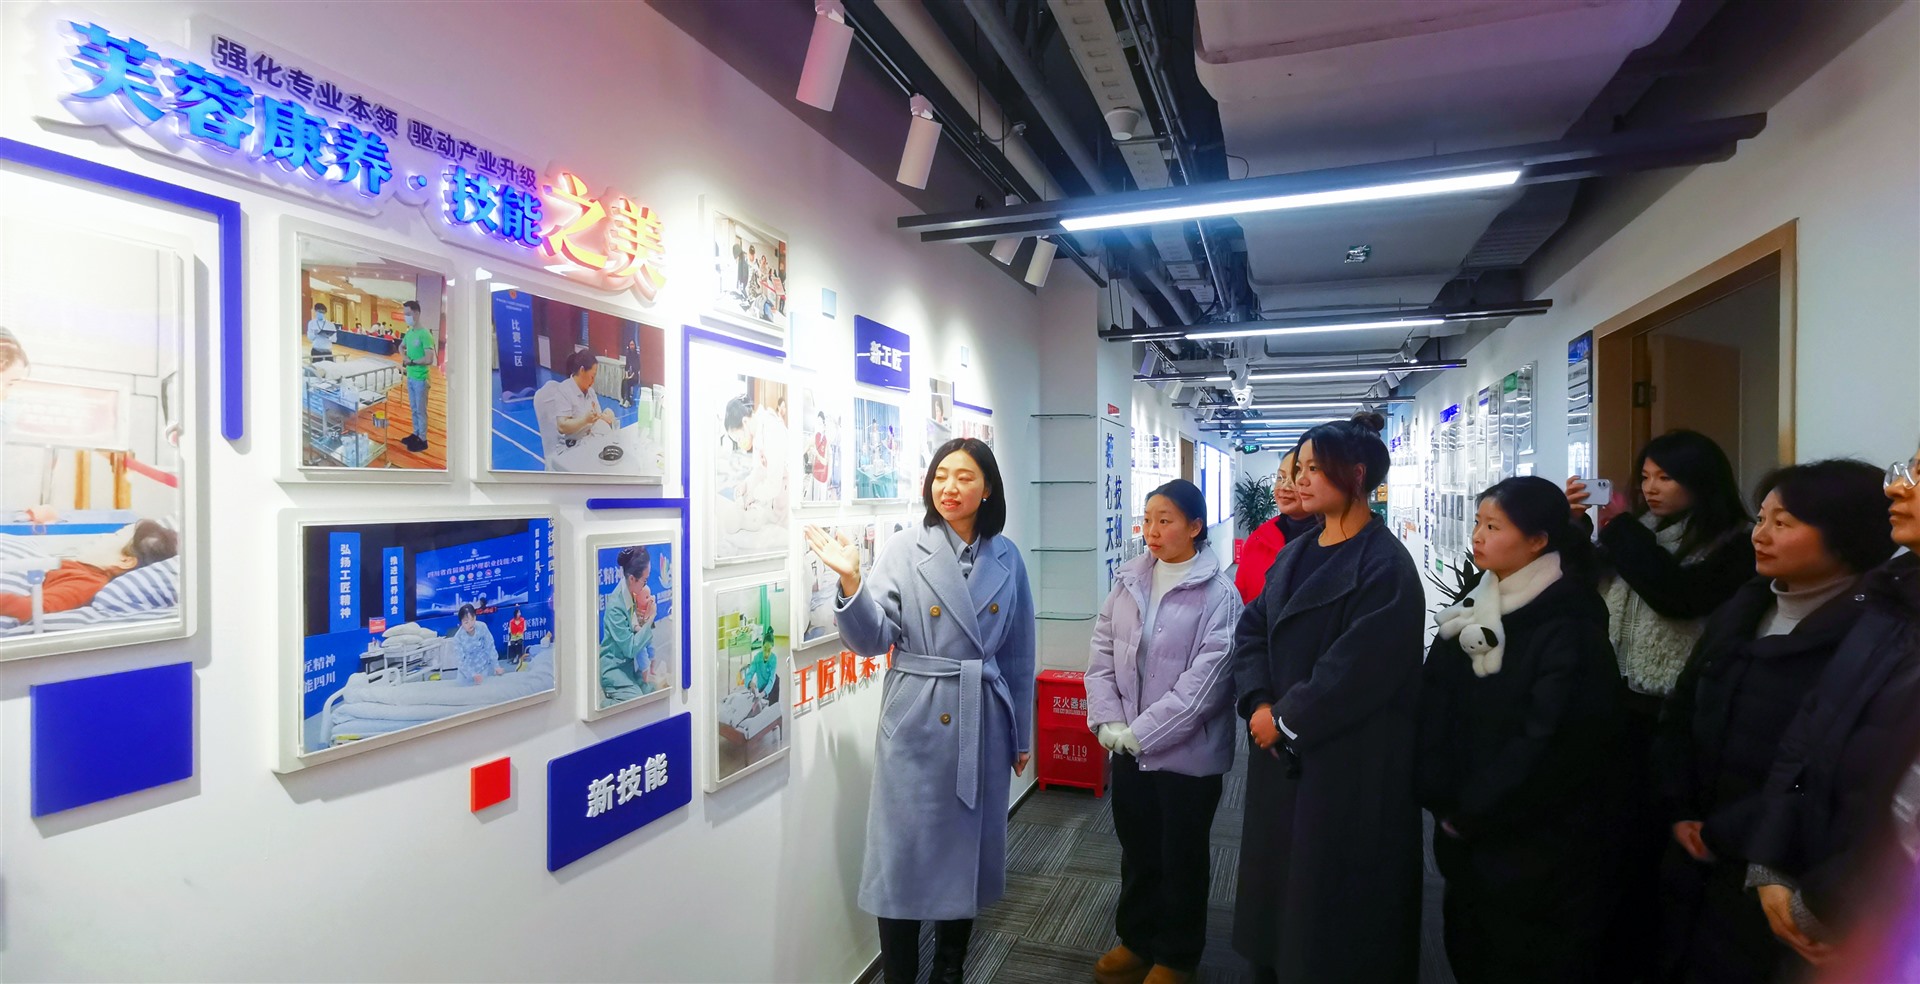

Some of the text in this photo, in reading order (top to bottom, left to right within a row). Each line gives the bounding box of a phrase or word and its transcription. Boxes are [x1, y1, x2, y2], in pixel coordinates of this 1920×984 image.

[215, 37, 537, 190] 强化专业本领 驱动产业升级
[511, 319, 523, 367] 比赛二区
[870, 340, 902, 372] 新工匠
[340, 544, 351, 619] 弘扬工匠精神
[1053, 696, 1087, 711] 灭火器箱
[586, 753, 668, 817] 新技能
